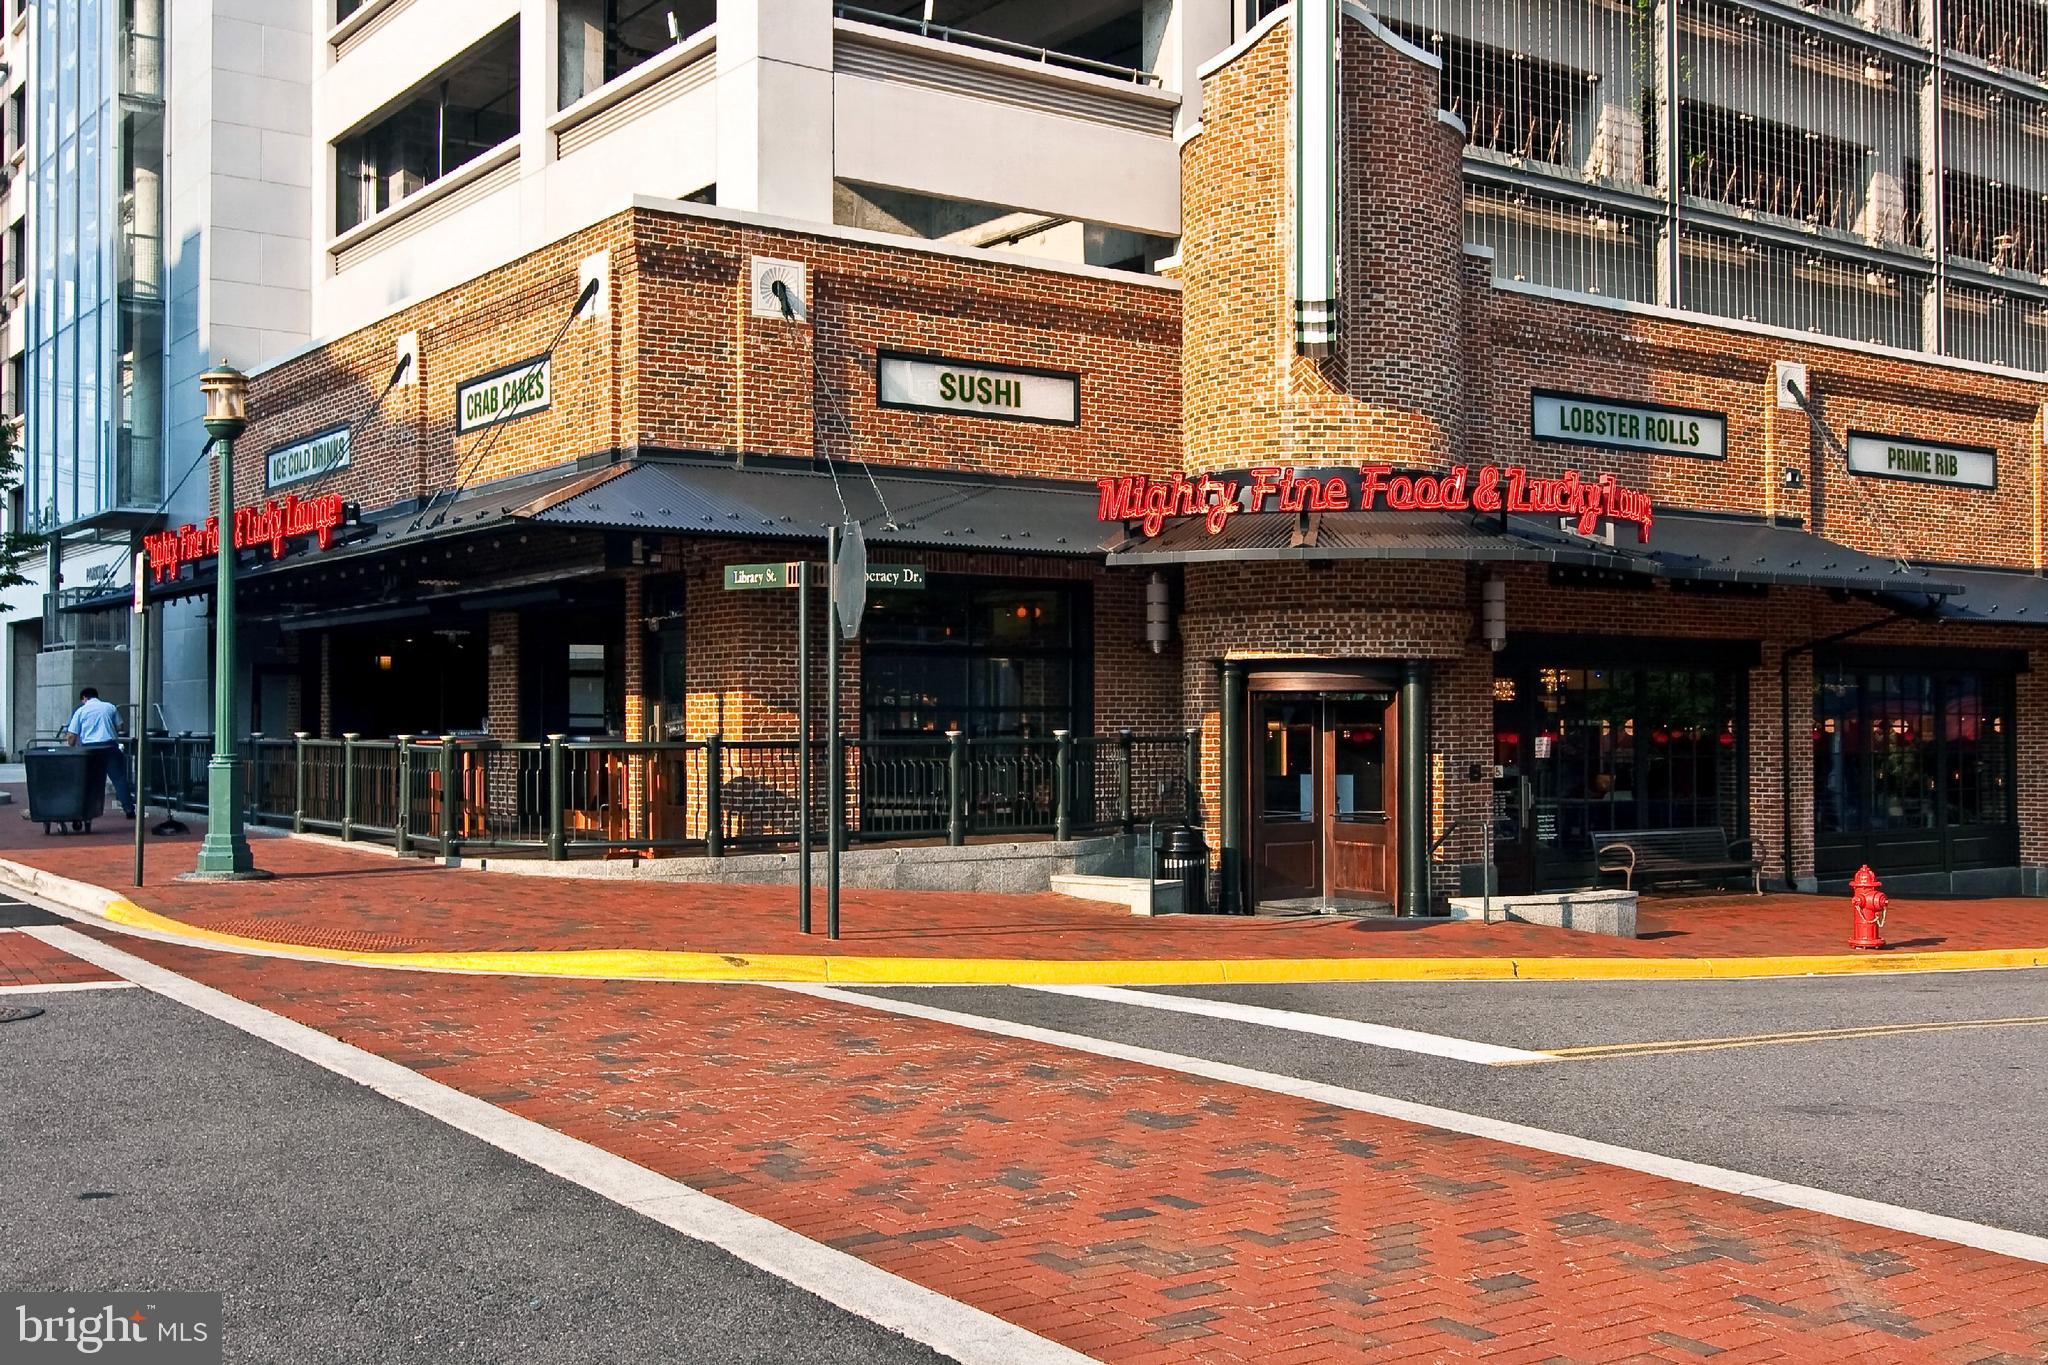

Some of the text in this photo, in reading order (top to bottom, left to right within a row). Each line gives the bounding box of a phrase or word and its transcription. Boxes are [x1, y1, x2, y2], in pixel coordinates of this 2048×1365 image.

[466, 369, 544, 421] CRAB CAKES
[940, 372, 1021, 408] SUSHI
[1560, 405, 1699, 446] LOBSTER ROLLS
[273, 437, 345, 481] ICE COLD DRINKS
[1887, 446, 1958, 477] PRIME RIB
[1098, 472, 1240, 537] Mighty
[1249, 465, 1350, 513] Fine
[1359, 463, 1470, 512] Food
[1472, 464, 1502, 512] &
[1504, 465, 1602, 536] Lucky
[179, 523, 205, 561] Fine
[205, 516, 219, 554] Fo
[245, 501, 285, 560] Lucky
[284, 492, 343, 550] Lounge
[733, 568, 777, 587] Library St.
[865, 568, 922, 586] ocracy Dr.
